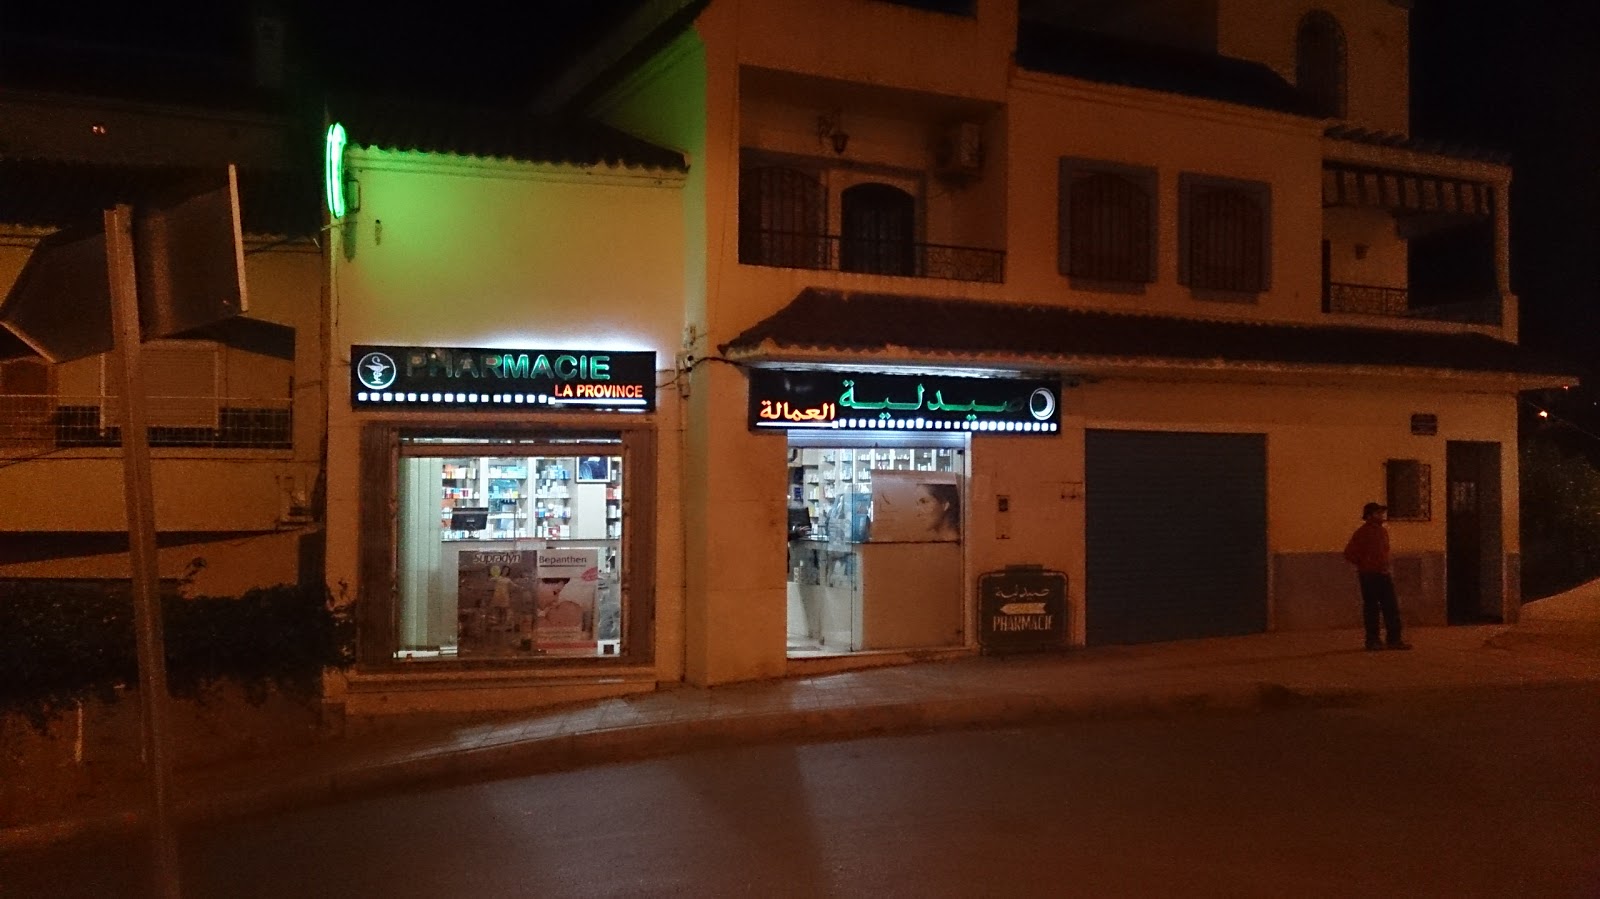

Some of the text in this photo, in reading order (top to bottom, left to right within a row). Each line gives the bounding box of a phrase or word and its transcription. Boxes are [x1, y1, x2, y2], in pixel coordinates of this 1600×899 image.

[406, 351, 611, 380] PHARMACIE
[554, 384, 643, 399] LA PROVINCE
[839, 379, 1025, 421] صيدلية
[759, 400, 836, 421] العمالة
[539, 555, 587, 565] Bepanthen
